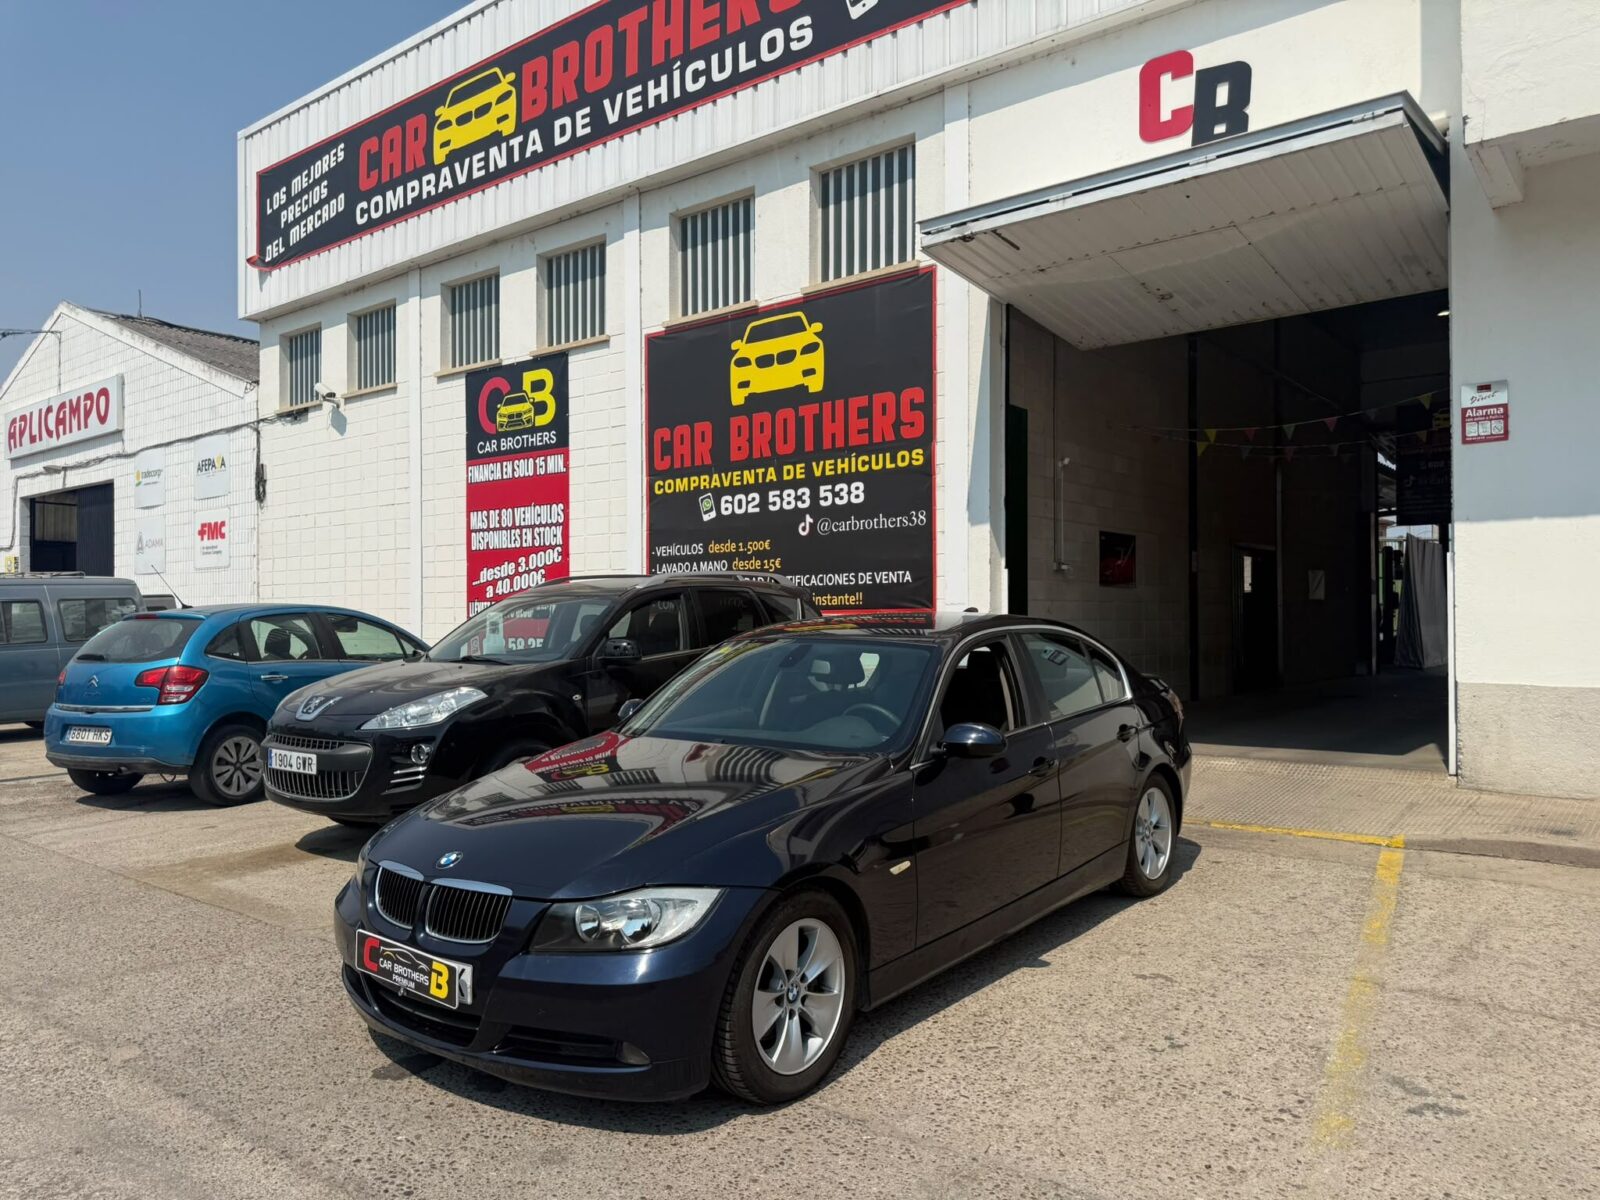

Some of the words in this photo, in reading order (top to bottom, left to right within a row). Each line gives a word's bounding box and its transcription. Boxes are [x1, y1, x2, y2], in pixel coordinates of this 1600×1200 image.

[358, 113, 428, 192] CAR
[521, 0, 802, 124] BROTHE
[355, 128, 544, 225] COMPRAVENTA
[553, 106, 591, 147] DE
[602, 15, 814, 125] VEHÍCULOS
[266, 186, 287, 216] LOS
[291, 142, 345, 197] MEJORES
[280, 179, 328, 229] PRECIOS
[265, 236, 285, 263] DEL
[289, 192, 345, 247] MERCADO
[8, 387, 111, 453] APLICAMPO
[1465, 407, 1504, 417] Alarma
[477, 439, 498, 454] CAR
[500, 430, 557, 451] BROTHERS
[653, 420, 713, 471] CAR
[729, 386, 925, 462] BROTHERS
[468, 462, 501, 484] FINANCIA
[503, 460, 513, 479] EN
[514, 458, 534, 478] SOLO
[535, 456, 546, 475] 15
[547, 453, 567, 474] MIN.
[654, 466, 777, 495] COMPRAVENTA
[783, 463, 806, 481] DE
[812, 448, 925, 477] VEHÍCULOS
[720, 492, 760, 515] 602
[768, 487, 811, 511] 583
[819, 481, 865, 507] 538
[470, 510, 488, 530] MAS
[489, 509, 500, 529] DE
[501, 508, 513, 527] 80
[514, 502, 564, 526] VEHÍCULOS
[816, 509, 927, 536] @carbrothers38
[198, 520, 226, 541] FMC
[471, 528, 520, 551] DISPONIBLES
[522, 528, 533, 547] EN
[534, 525, 562, 547] STOCK
[518, 546, 562, 572] 3.000€
[656, 543, 704, 557] VEHÍCULOS
[708, 540, 737, 554] desde
[738, 539, 771, 554] 1.500€
[656, 561, 691, 574] LAVADO
[691, 562, 698, 572] A
[700, 559, 728, 572] MANO
[732, 557, 761, 571] desde
[763, 557, 782, 572] 15€
[858, 572, 873, 585] DE
[874, 570, 912, 584] VENTA
[486, 585, 494, 598] a
[495, 568, 546, 596] 40.000€
[812, 592, 863, 606] instante!!
[274, 752, 293, 769] 1904
[296, 756, 313, 772] GWR
[363, 937, 380, 972] C
[378, 958, 392, 971] CAR
[393, 963, 429, 986] BROTHERS
[392, 973, 415, 989] PREMIUM
[429, 960, 449, 999] B
